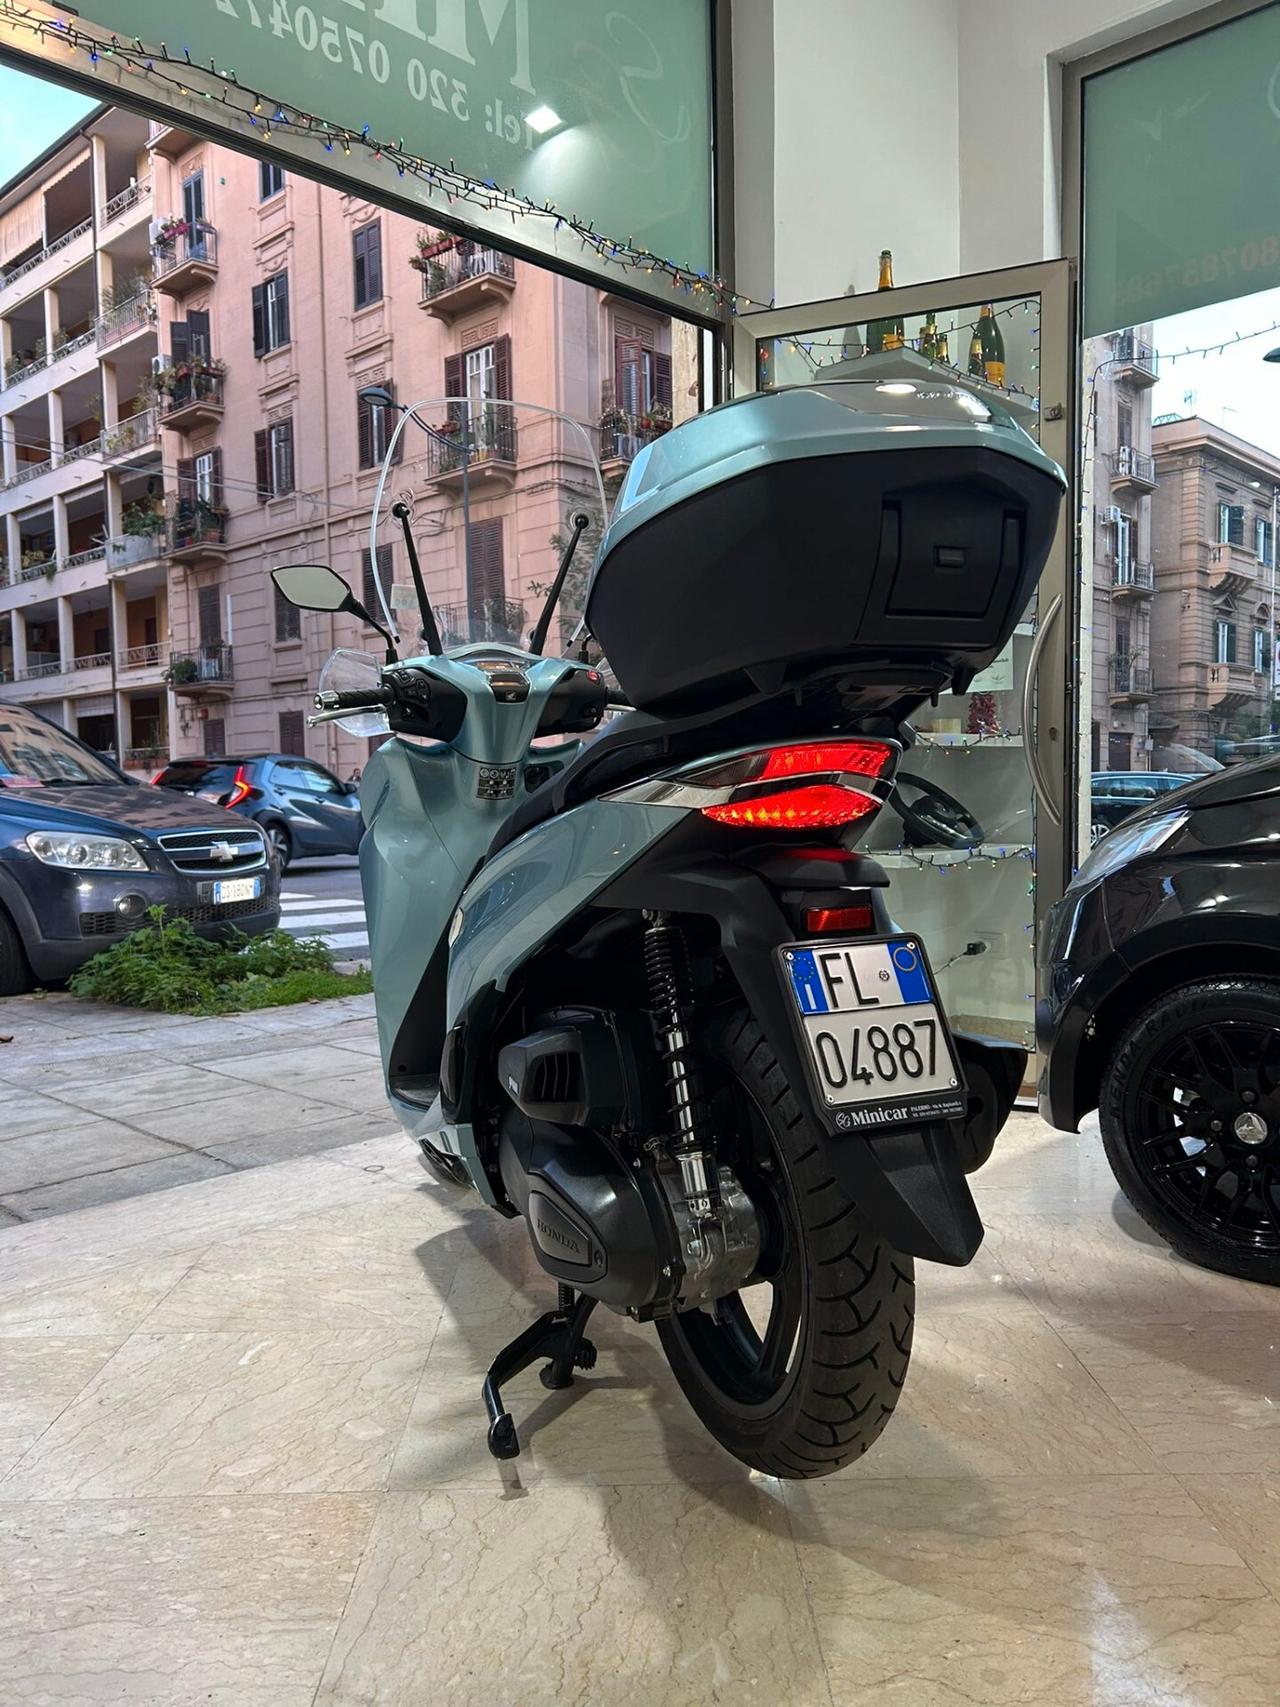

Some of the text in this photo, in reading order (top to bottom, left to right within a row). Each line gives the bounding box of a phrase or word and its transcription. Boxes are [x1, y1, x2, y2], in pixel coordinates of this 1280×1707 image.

[818, 952, 880, 1009] FL
[815, 1018, 936, 1089] 04887
[851, 1107, 908, 1126] Minicar
[537, 1218, 581, 1254] HONDA
